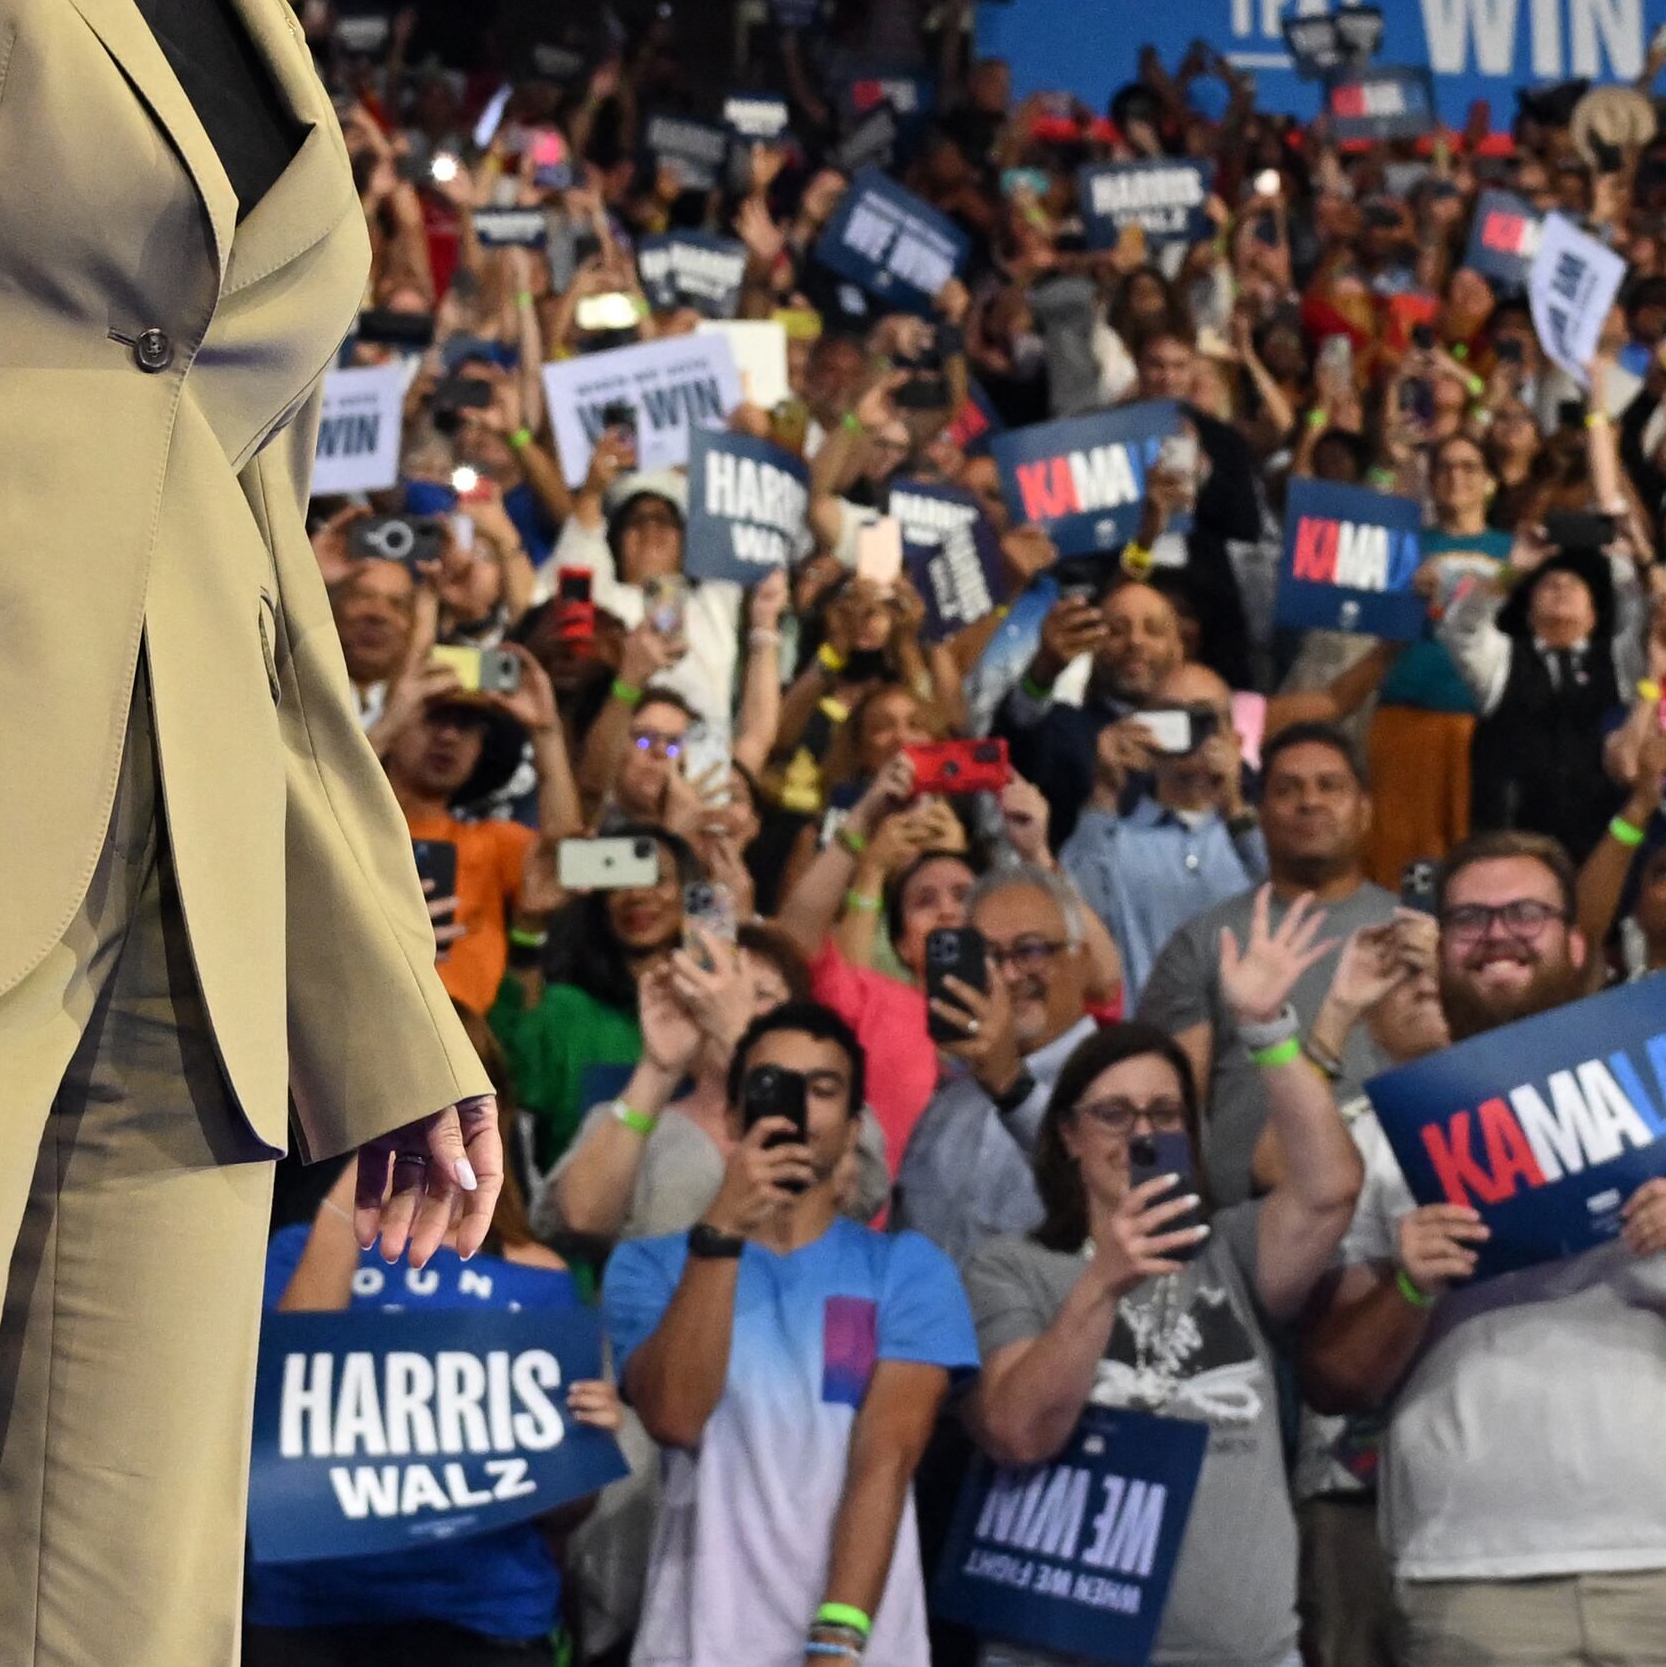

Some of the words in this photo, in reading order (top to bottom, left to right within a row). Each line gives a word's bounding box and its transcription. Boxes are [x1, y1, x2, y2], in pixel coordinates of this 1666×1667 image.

[1090, 165, 1205, 216] HARRIS
[641, 377, 724, 430] WIN
[318, 413, 381, 458] WIN
[280, 1348, 566, 1458] HARRIS
[328, 1457, 538, 1520] WALZ
[974, 1463, 1091, 1560] WIN
[1081, 1473, 1168, 1579] WE
[963, 1547, 1034, 1589] FIGHT
[1032, 1564, 1073, 1598] WE
[1071, 1573, 1141, 1615] WHEN
